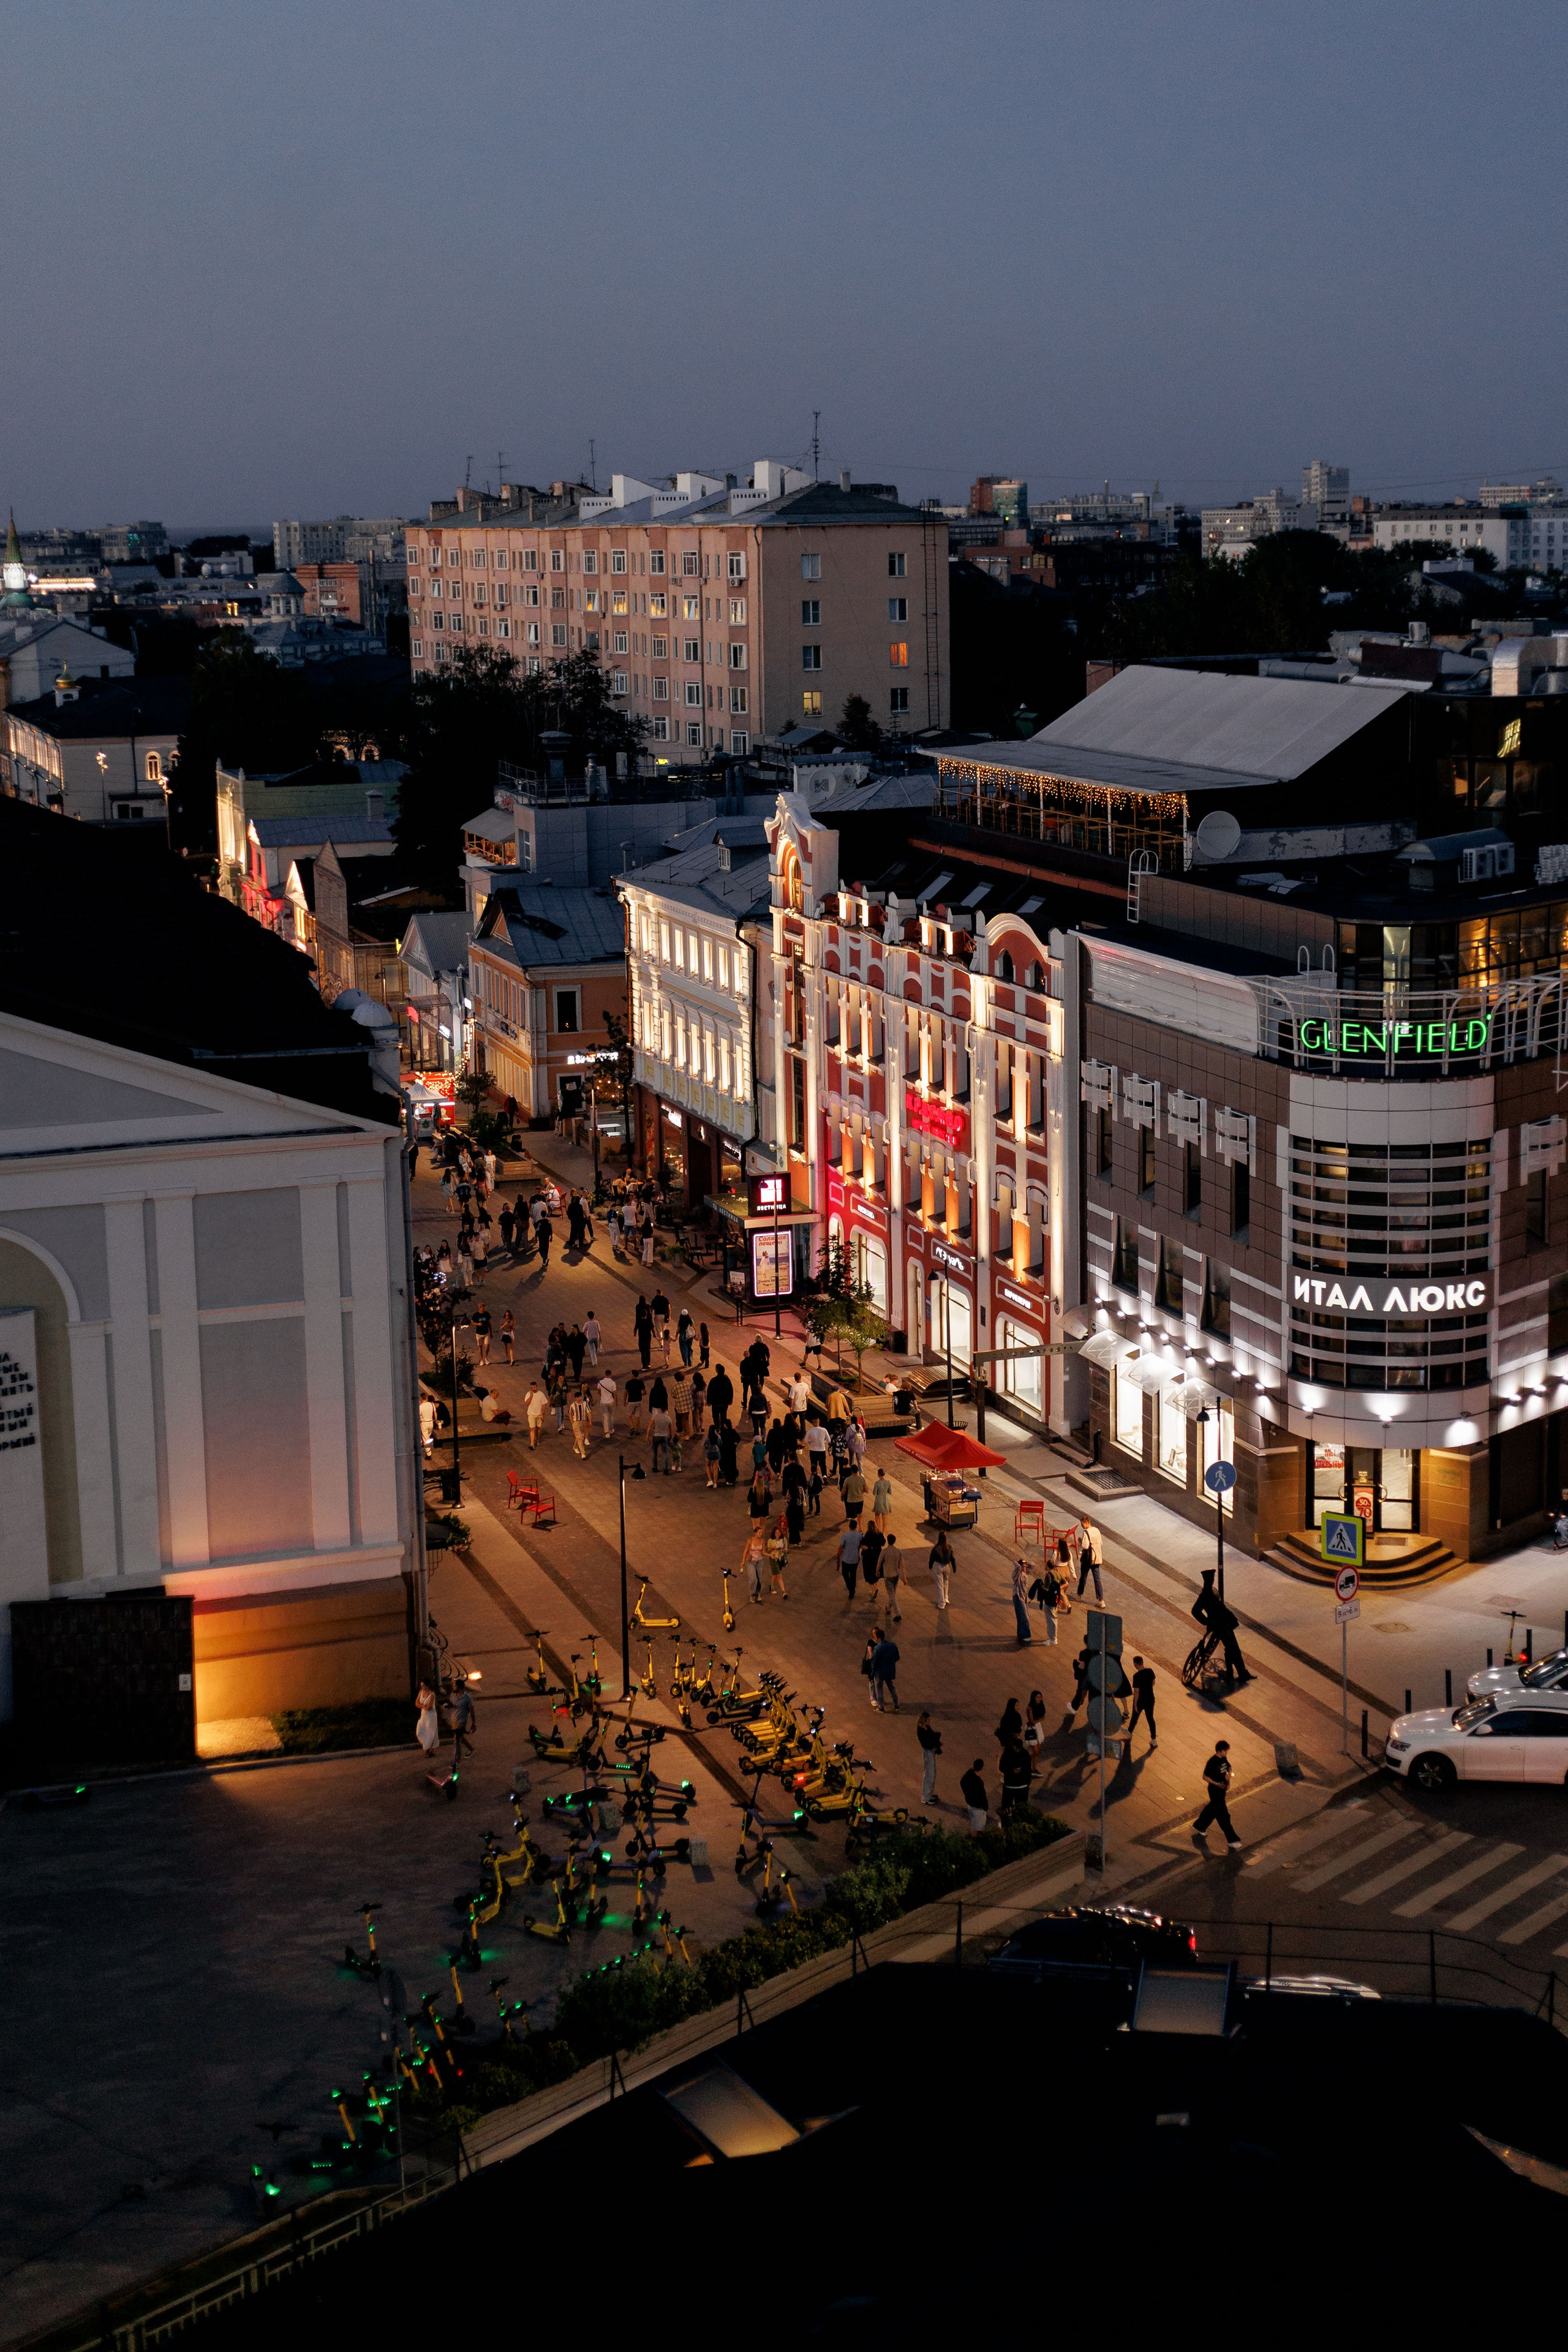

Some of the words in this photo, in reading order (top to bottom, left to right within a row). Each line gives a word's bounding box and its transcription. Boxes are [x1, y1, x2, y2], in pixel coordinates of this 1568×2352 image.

[1300, 1019, 1488, 1053] GLENFIELD
[1294, 1275, 1374, 1311] ИТАЛ
[1383, 1280, 1486, 1312] ЛЮКС
[0, 1433, 35, 1451] РЬКИЙ
